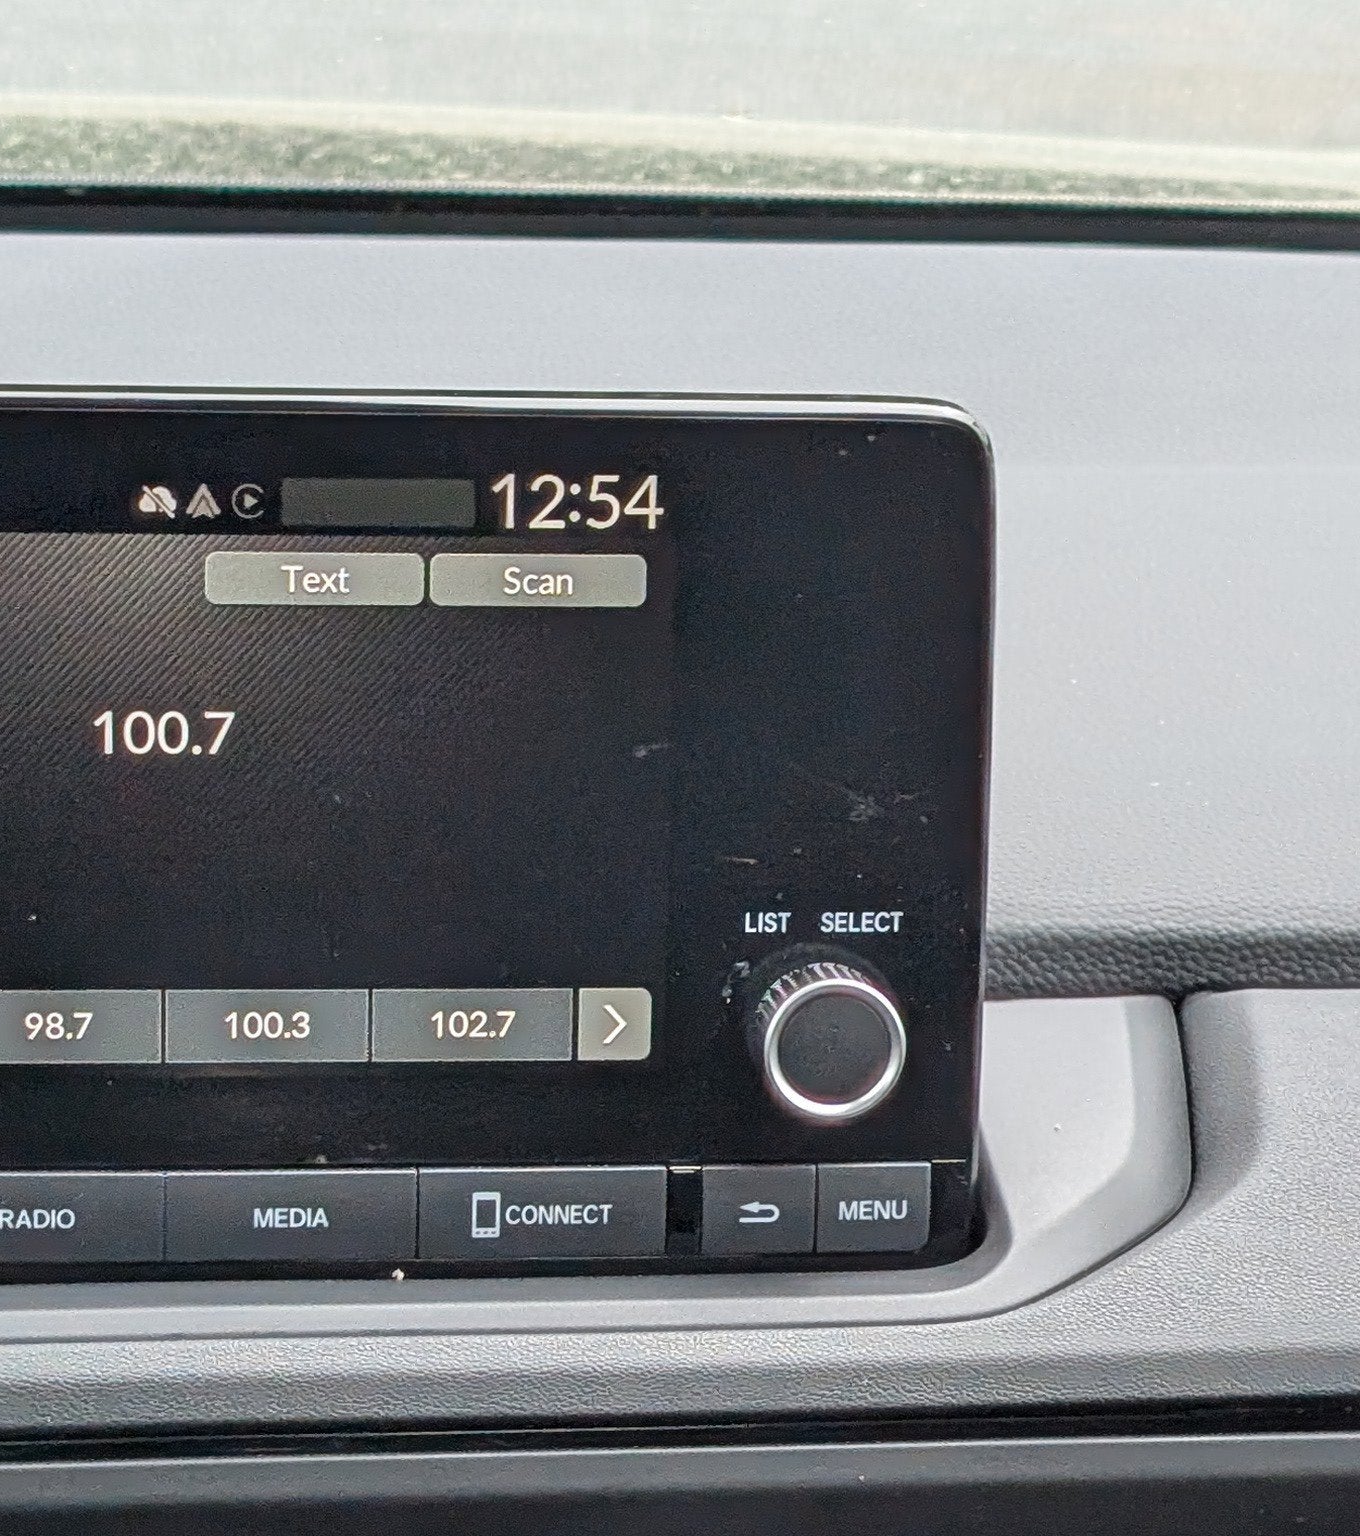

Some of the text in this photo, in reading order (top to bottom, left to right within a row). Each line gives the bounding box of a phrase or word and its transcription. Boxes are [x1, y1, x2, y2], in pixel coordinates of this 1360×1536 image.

[491, 473, 665, 530] 12:54
[280, 564, 350, 594] Text
[503, 566, 573, 595] Scan
[93, 710, 236, 756] 100.7
[744, 911, 792, 934] LIST
[820, 911, 904, 934] SELECT
[24, 1011, 94, 1040] 98.7
[224, 1010, 311, 1039] 100.3
[430, 1010, 516, 1039] 102.7
[253, 1207, 329, 1229] MEDIA
[505, 1203, 613, 1226] CONNECT
[838, 1199, 908, 1221] MENU
